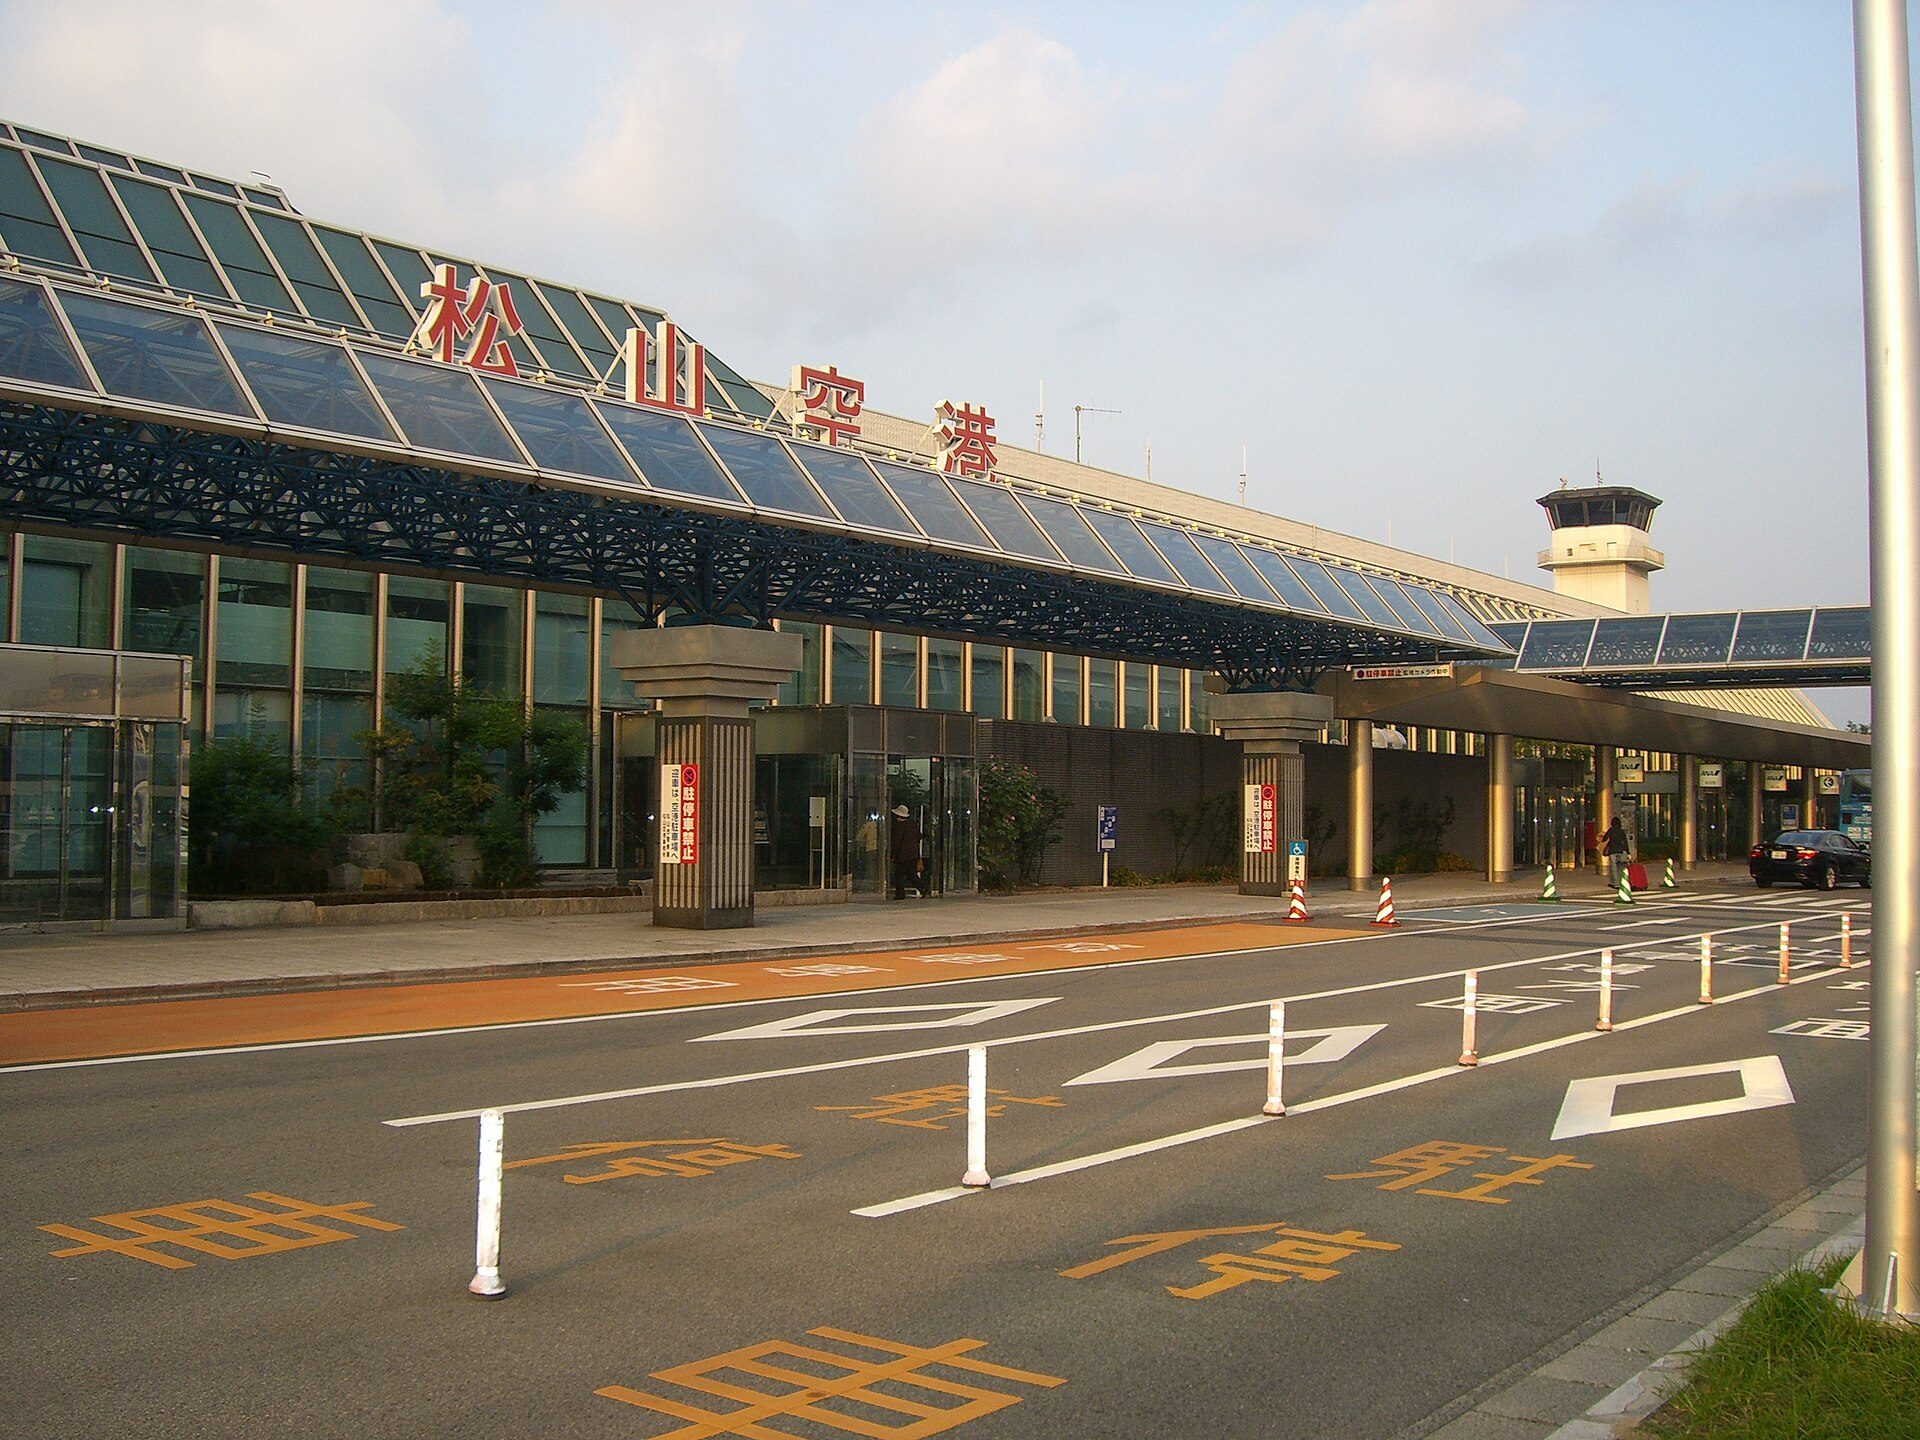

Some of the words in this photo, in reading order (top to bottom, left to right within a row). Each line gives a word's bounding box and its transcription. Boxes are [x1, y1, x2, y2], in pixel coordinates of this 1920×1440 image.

[420, 263, 998, 484] 松山空港
[1365, 668, 1402, 678] 駐停車禁止
[683, 786, 695, 860] 駐停車禁止
[1262, 799, 1274, 851] 駐停車禁止
